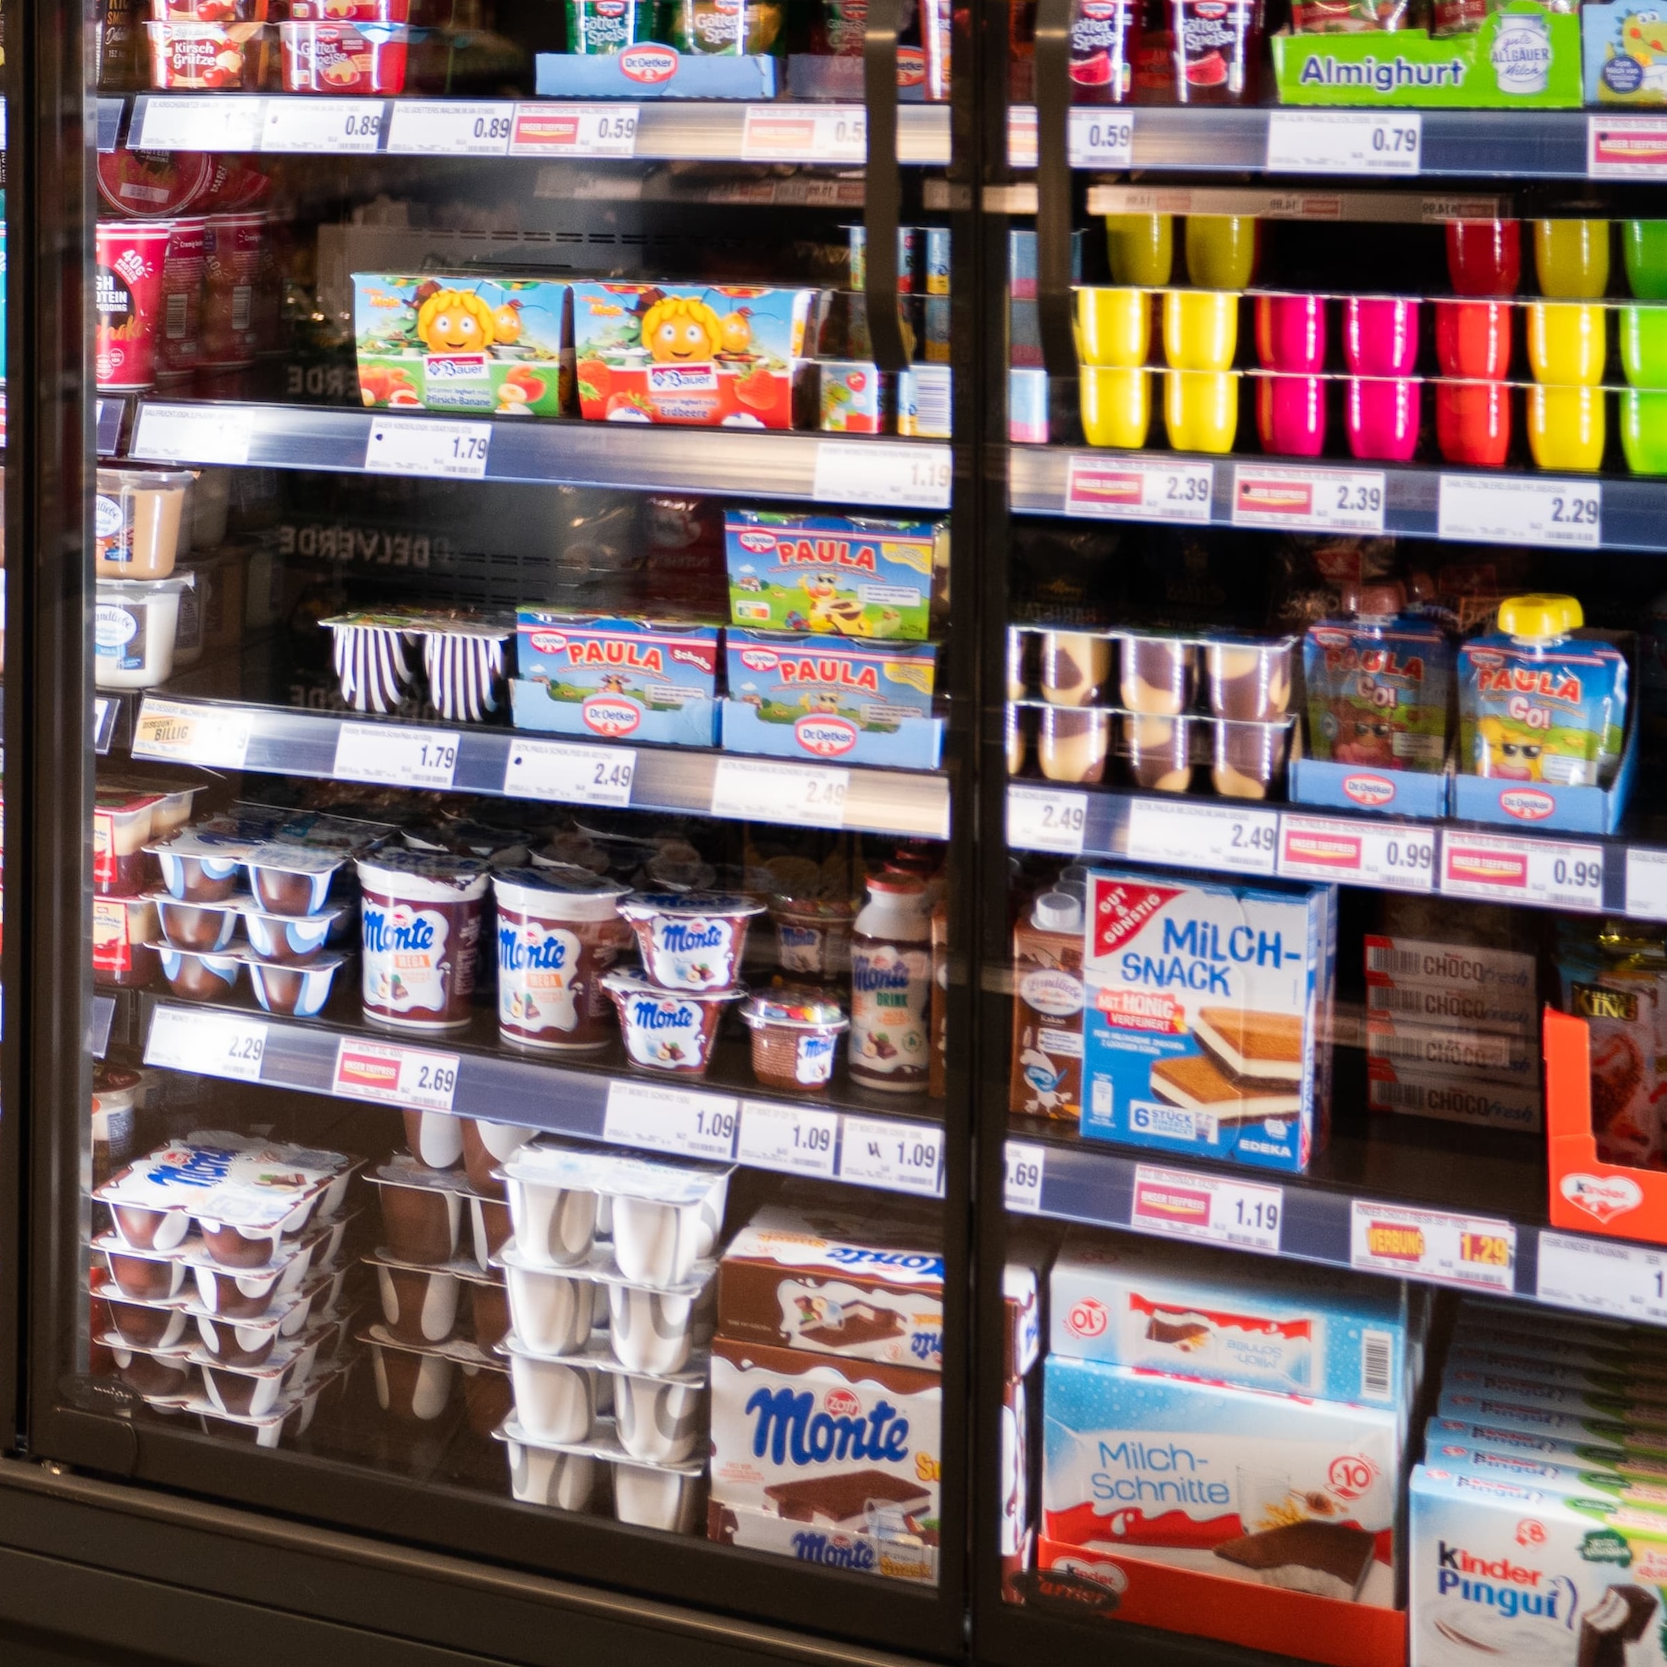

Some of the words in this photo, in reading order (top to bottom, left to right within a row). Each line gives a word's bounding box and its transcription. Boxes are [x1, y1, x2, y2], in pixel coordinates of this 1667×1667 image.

[1301, 56, 1466, 93] Almighurt
[345, 115, 380, 135] 0.89
[474, 118, 509, 138] 0.89
[598, 118, 634, 139] 0.59
[1089, 125, 1130, 149] 0.59
[1373, 129, 1417, 153] 0.79
[443, 358, 484, 377] Bauer
[661, 407, 709, 418] Erdbeere
[453, 438, 486, 459] 1.79
[1167, 476, 1209, 502] 2.39
[1338, 485, 1380, 511] 2.39
[1551, 498, 1598, 525] 2.29
[776, 540, 876, 572] PAULA
[567, 641, 663, 672] PAULA
[780, 659, 878, 691] PAULA
[1509, 696, 1550, 729] GO!
[421, 742, 456, 768] 1.79
[594, 763, 631, 787] 2.49
[1043, 805, 1084, 831] 2.49
[1232, 826, 1274, 851] 2.49
[1387, 841, 1432, 870] 0.99
[1554, 859, 1601, 888] 0.99
[1099, 887, 1126, 914] GUT
[1103, 894, 1161, 945] GÜNSTIG
[662, 924, 723, 952] Monte
[1121, 953, 1232, 997] SNACK
[1423, 955, 1483, 981] CHOCO
[877, 991, 908, 1008] DRINK
[1110, 1012, 1171, 1032] VERFEINERT
[228, 1035, 265, 1063] 2.29
[418, 1066, 455, 1091] 2.69
[697, 1112, 734, 1138] 1.09
[1152, 1109, 1192, 1124] STÜCK
[793, 1126, 830, 1151] 1.09
[1239, 1138, 1292, 1157] EDEKA
[897, 1141, 936, 1168] 1.09
[1141, 1192, 1166, 1204] UNSER
[1235, 1199, 1278, 1229] 1.19
[1367, 1226, 1425, 1261] WERBUNG
[1461, 1232, 1509, 1267] 1.29
[744, 1386, 911, 1467] Monte
[1097, 1440, 1209, 1474] Milch-
[1091, 1473, 1230, 1507] Schnitte
